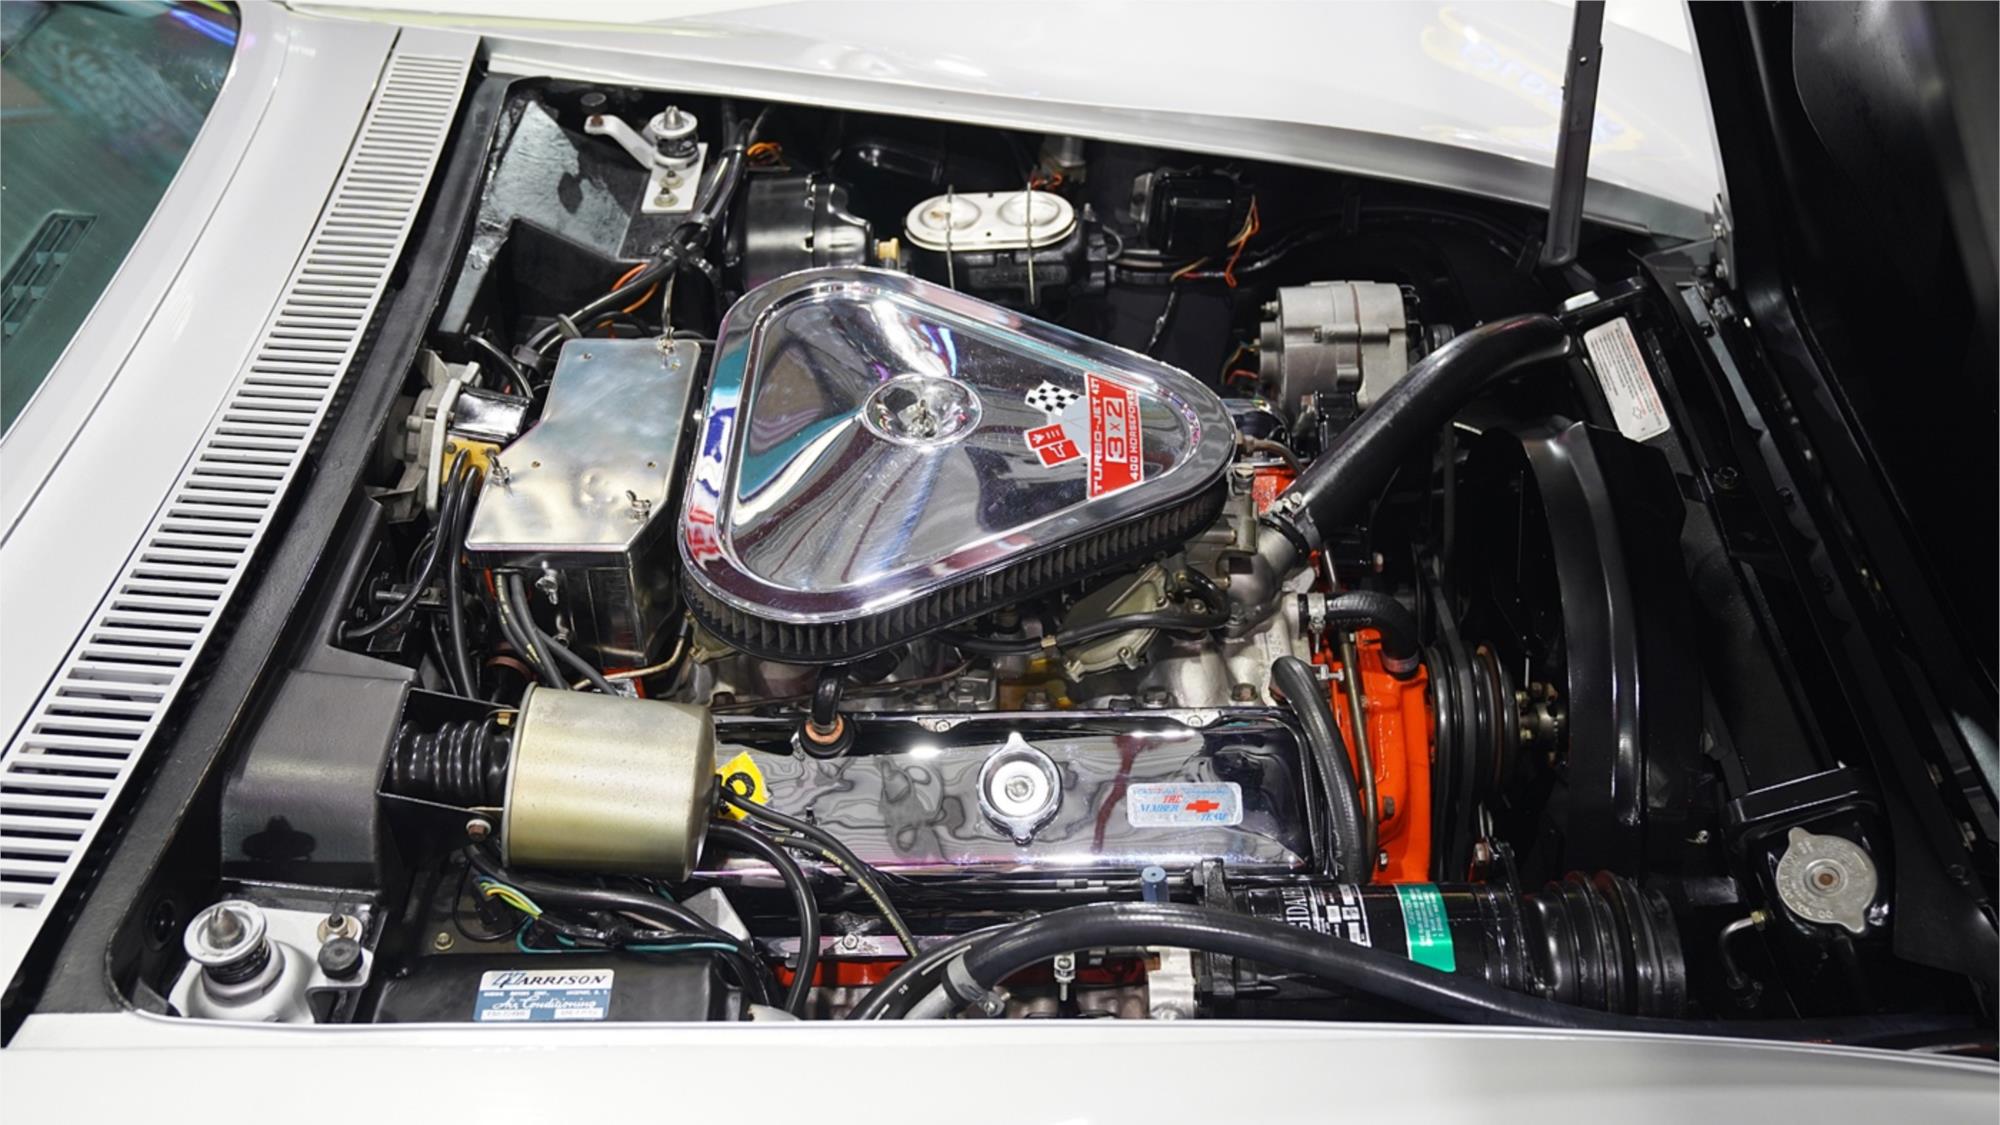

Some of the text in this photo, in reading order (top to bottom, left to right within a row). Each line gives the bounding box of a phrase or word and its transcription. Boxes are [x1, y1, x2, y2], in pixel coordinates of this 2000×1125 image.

[1106, 400, 1123, 418] 2
[1092, 397, 1103, 493] TURBO-JET
[1107, 436, 1124, 459] 3
[1130, 456, 1139, 481] 400
[492, 972, 606, 988] HARRISON
